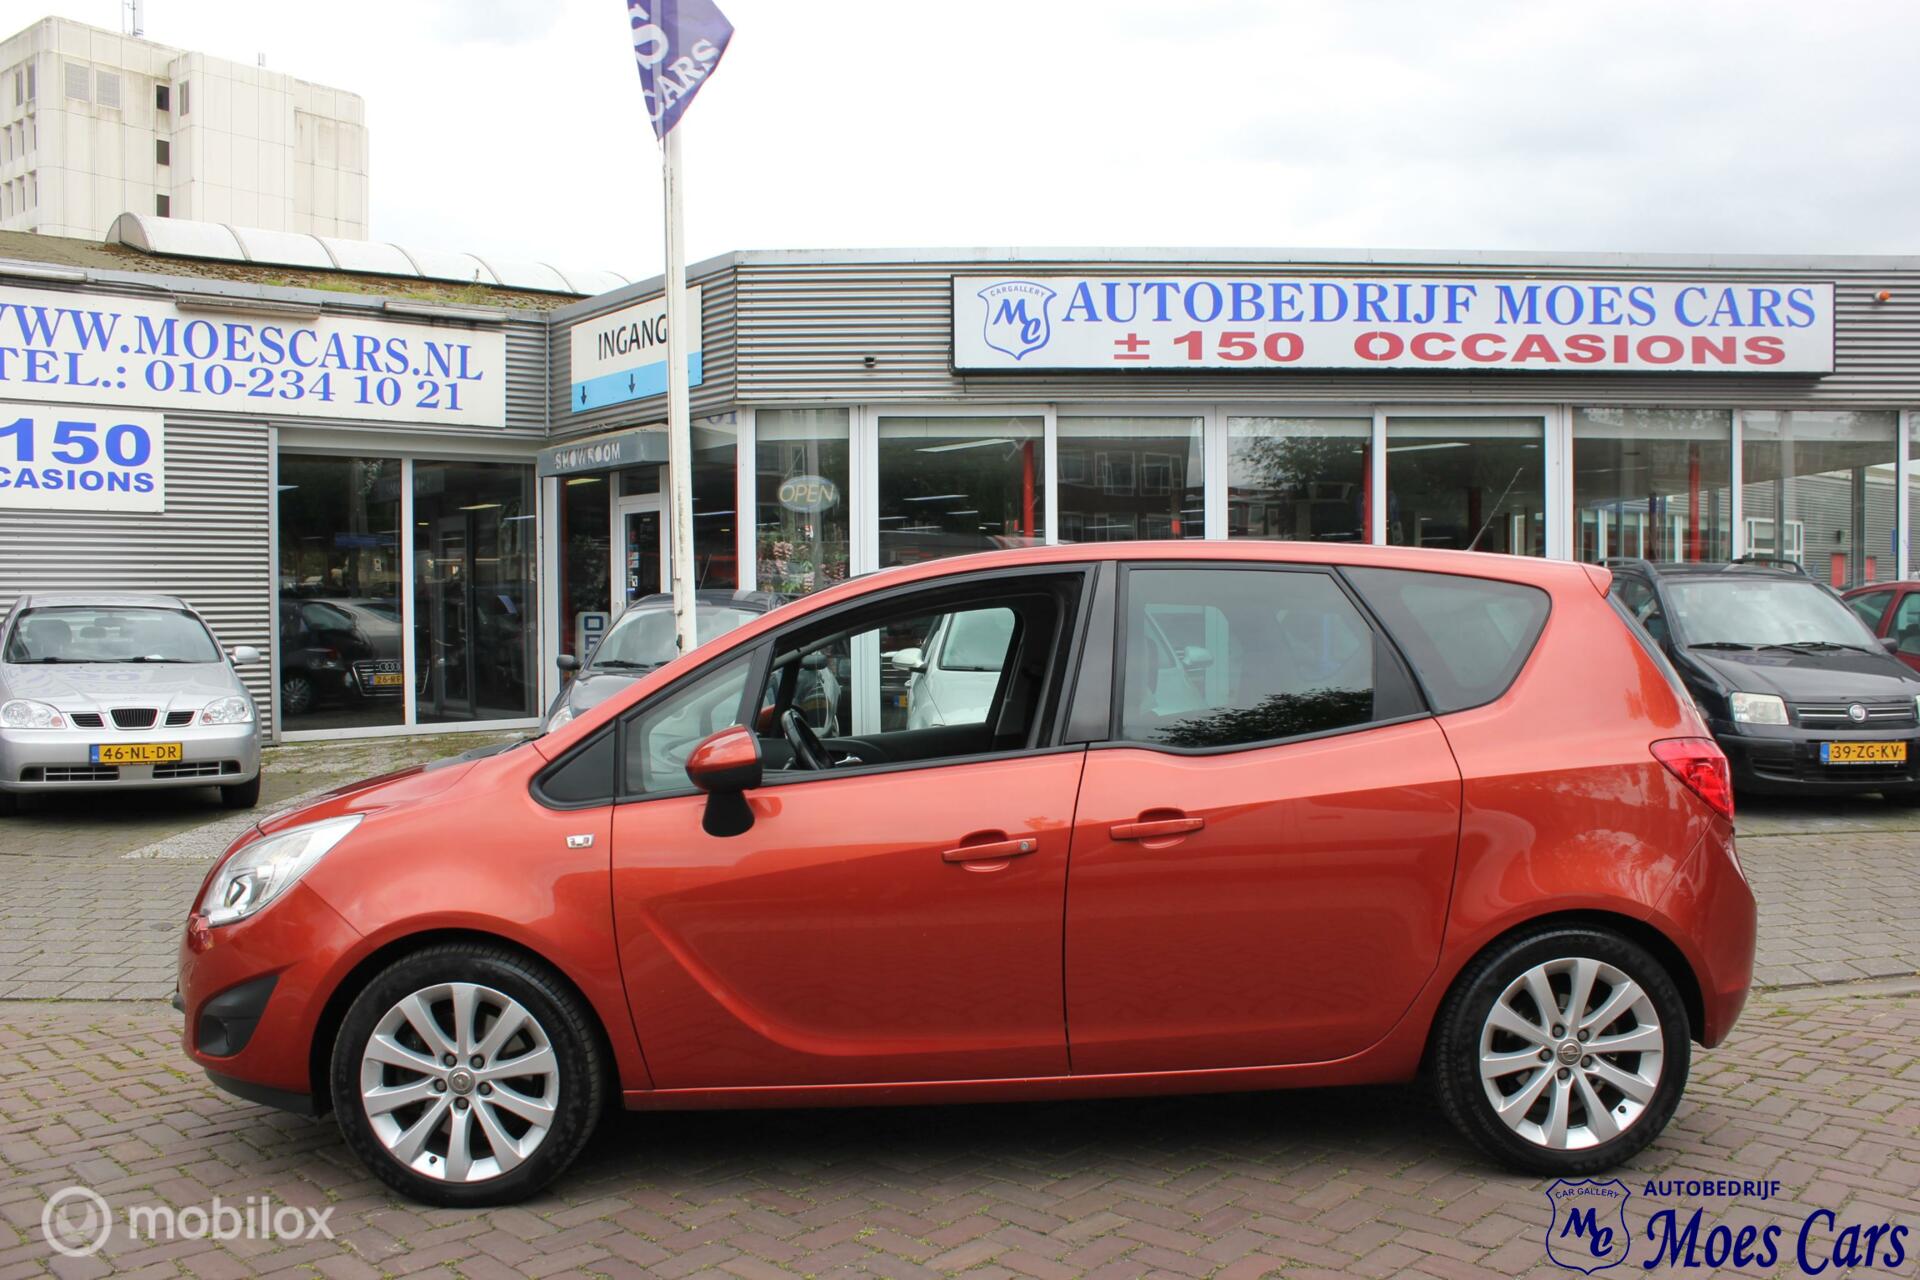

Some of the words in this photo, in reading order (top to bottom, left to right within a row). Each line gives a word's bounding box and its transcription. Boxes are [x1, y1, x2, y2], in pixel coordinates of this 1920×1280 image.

[1061, 281, 1478, 324] AUTOBEDRIJF
[1494, 284, 1657, 328] MOES
[1673, 286, 1816, 329] CARS
[0, 303, 484, 381] WW.MOESCARS.NL
[598, 314, 667, 361] INGANG
[1173, 331, 1305, 362] 150
[1354, 331, 1786, 365] OCCASIONS
[145, 360, 335, 402] 010-234
[354, 375, 402, 407] 10
[416, 380, 464, 411] 21
[0, 417, 151, 468] 150
[555, 442, 621, 470] SHOWROOM
[779, 483, 835, 503] OPEN
[103, 746, 177, 760] 46-NL-DR
[1833, 745, 1900, 759] 39-ZG-KV
